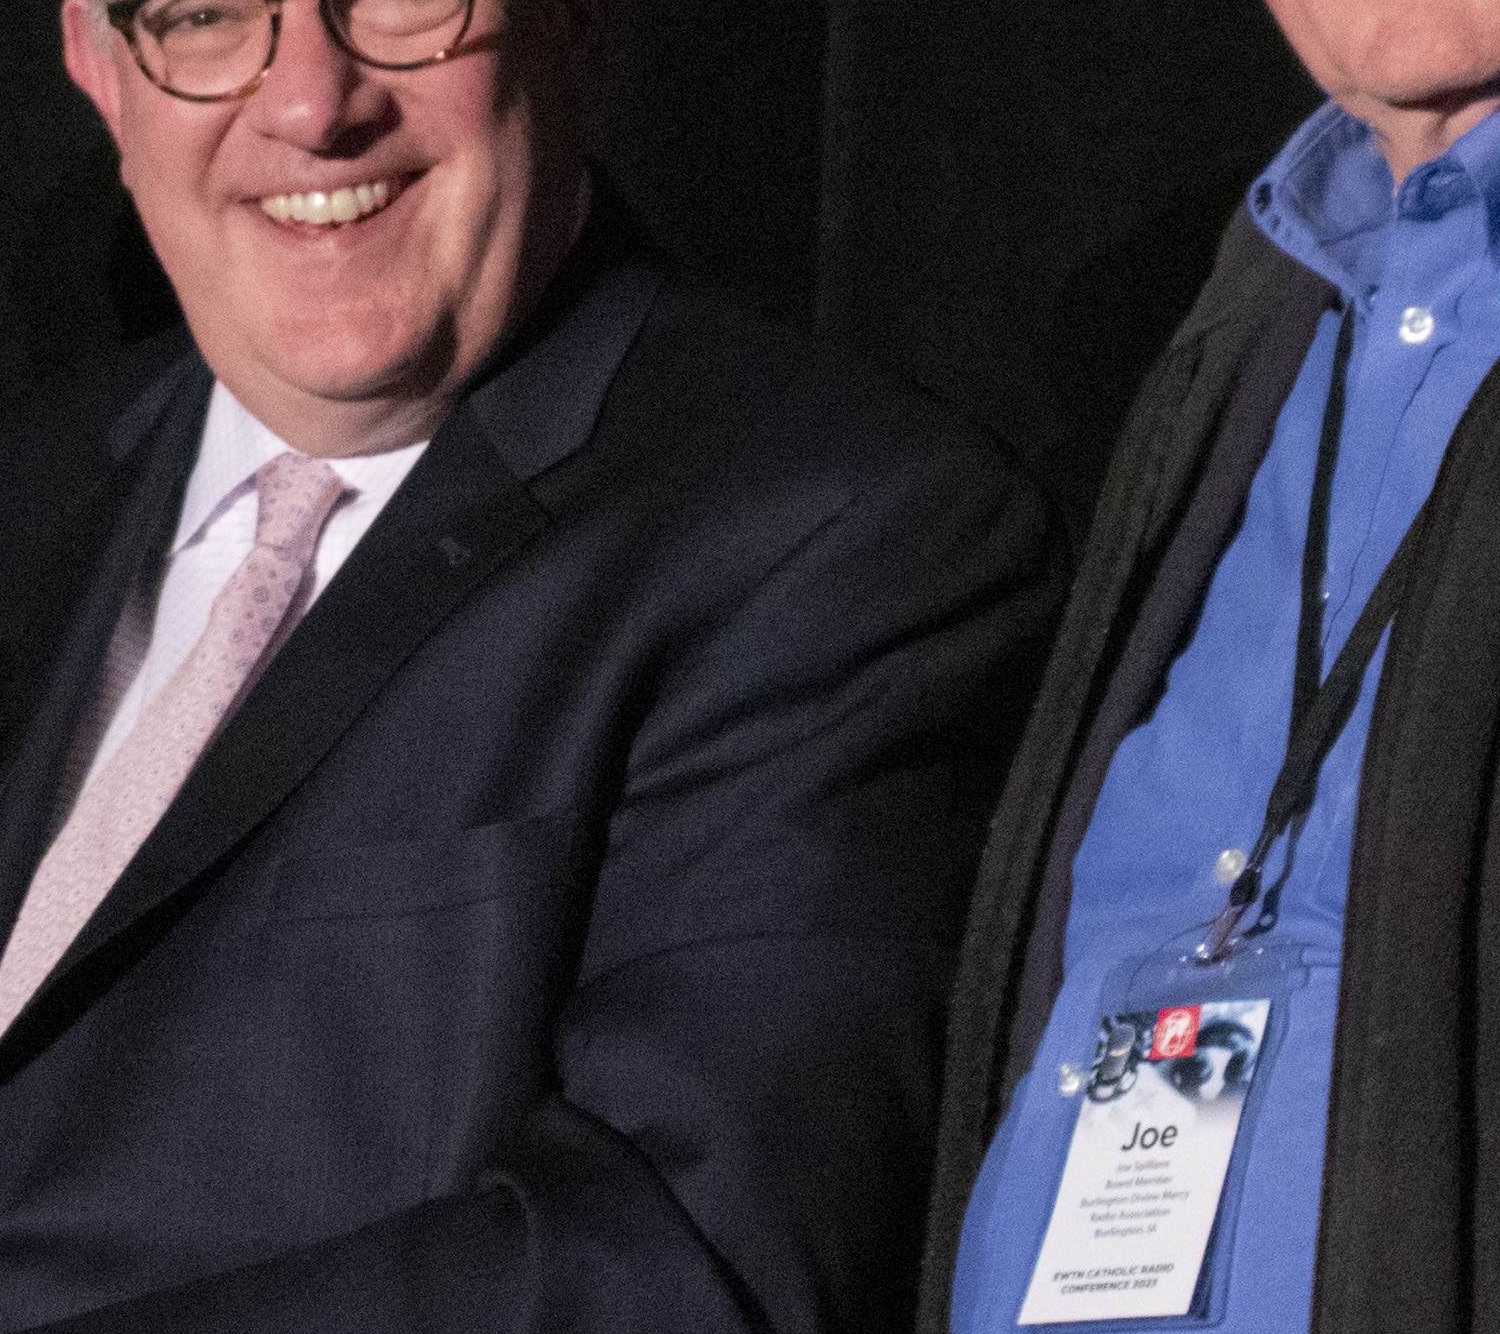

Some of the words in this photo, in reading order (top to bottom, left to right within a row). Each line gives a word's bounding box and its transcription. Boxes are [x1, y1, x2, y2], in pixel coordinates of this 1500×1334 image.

[1121, 1122, 1178, 1152] Joe
[1135, 1176, 1173, 1187] Member
[1162, 1190, 1190, 1202] Mercy
[1053, 1270, 1084, 1281] EWTN
[1087, 1266, 1138, 1279] CATHOLIC
[1140, 1263, 1175, 1274] RADIO
[1061, 1280, 1130, 1295] CONFERENCE
